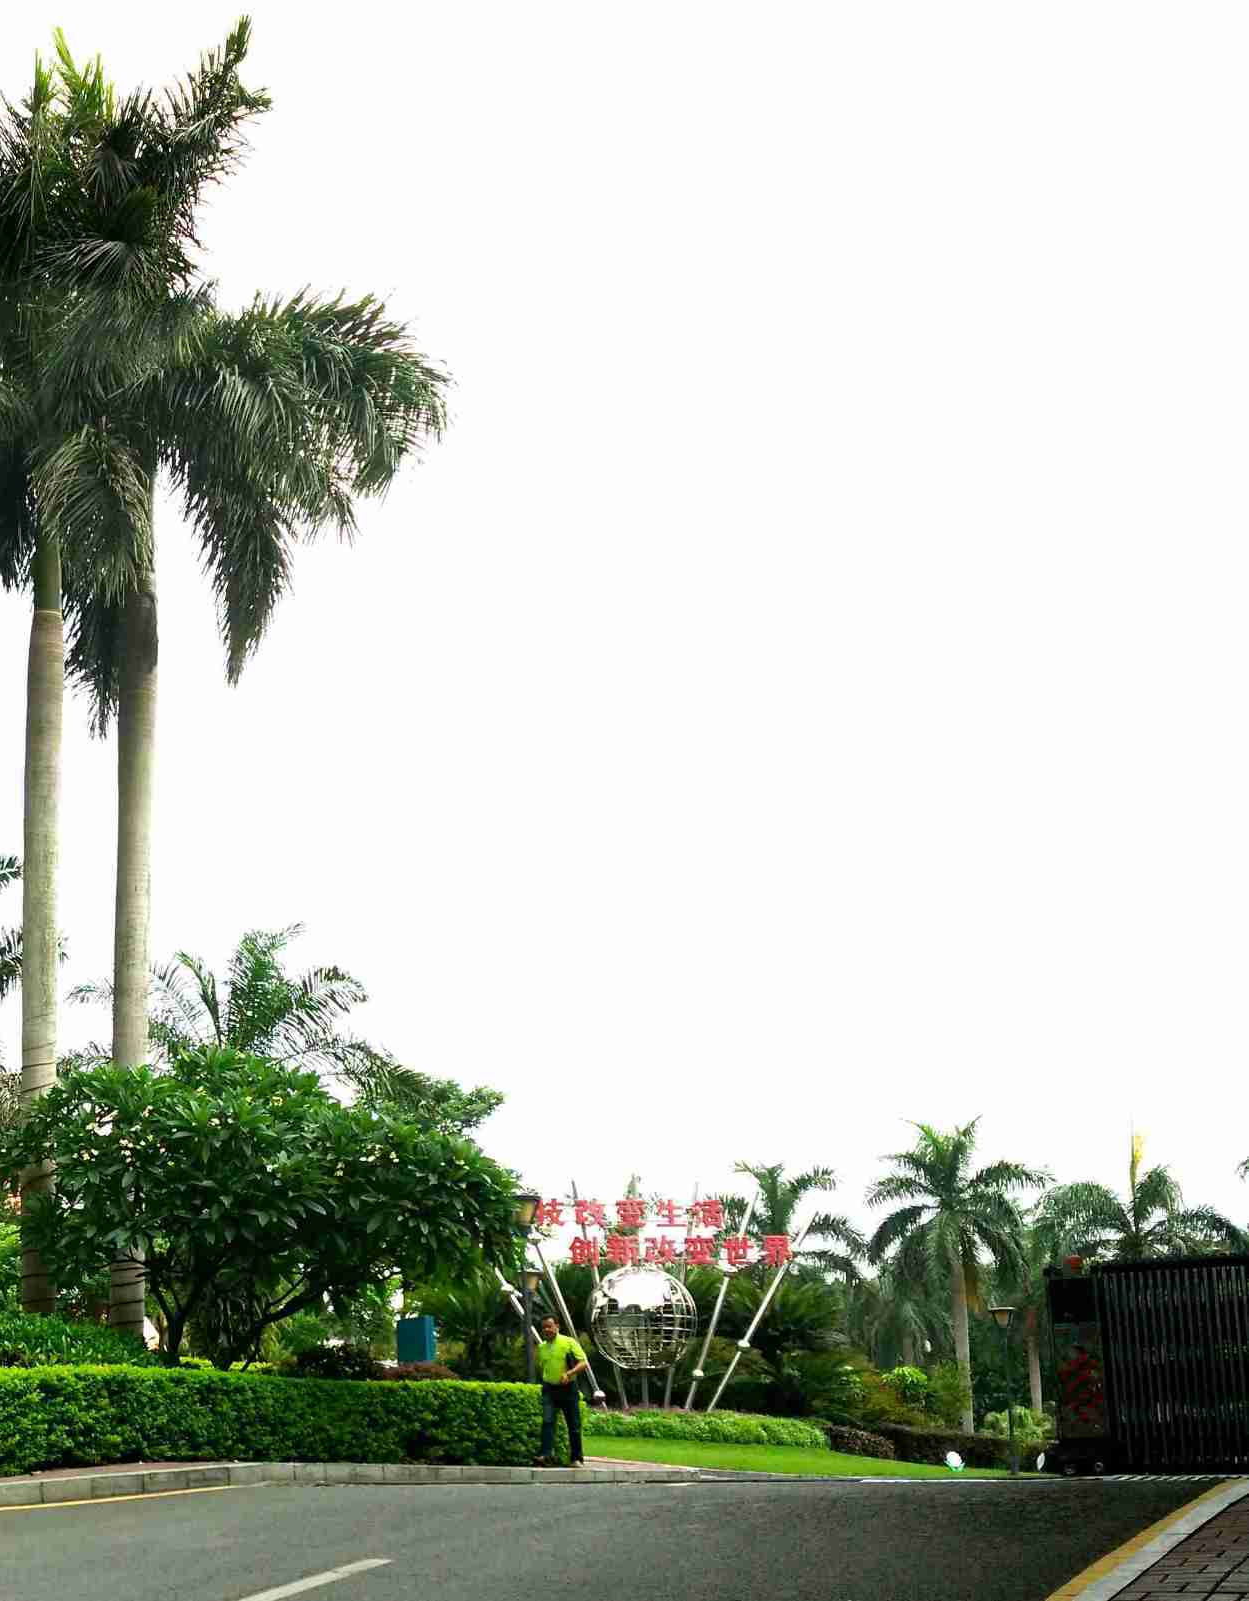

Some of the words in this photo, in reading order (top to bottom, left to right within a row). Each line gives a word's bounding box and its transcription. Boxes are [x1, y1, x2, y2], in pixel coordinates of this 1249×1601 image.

[569, 1232, 795, 1267] 创新改变世界
